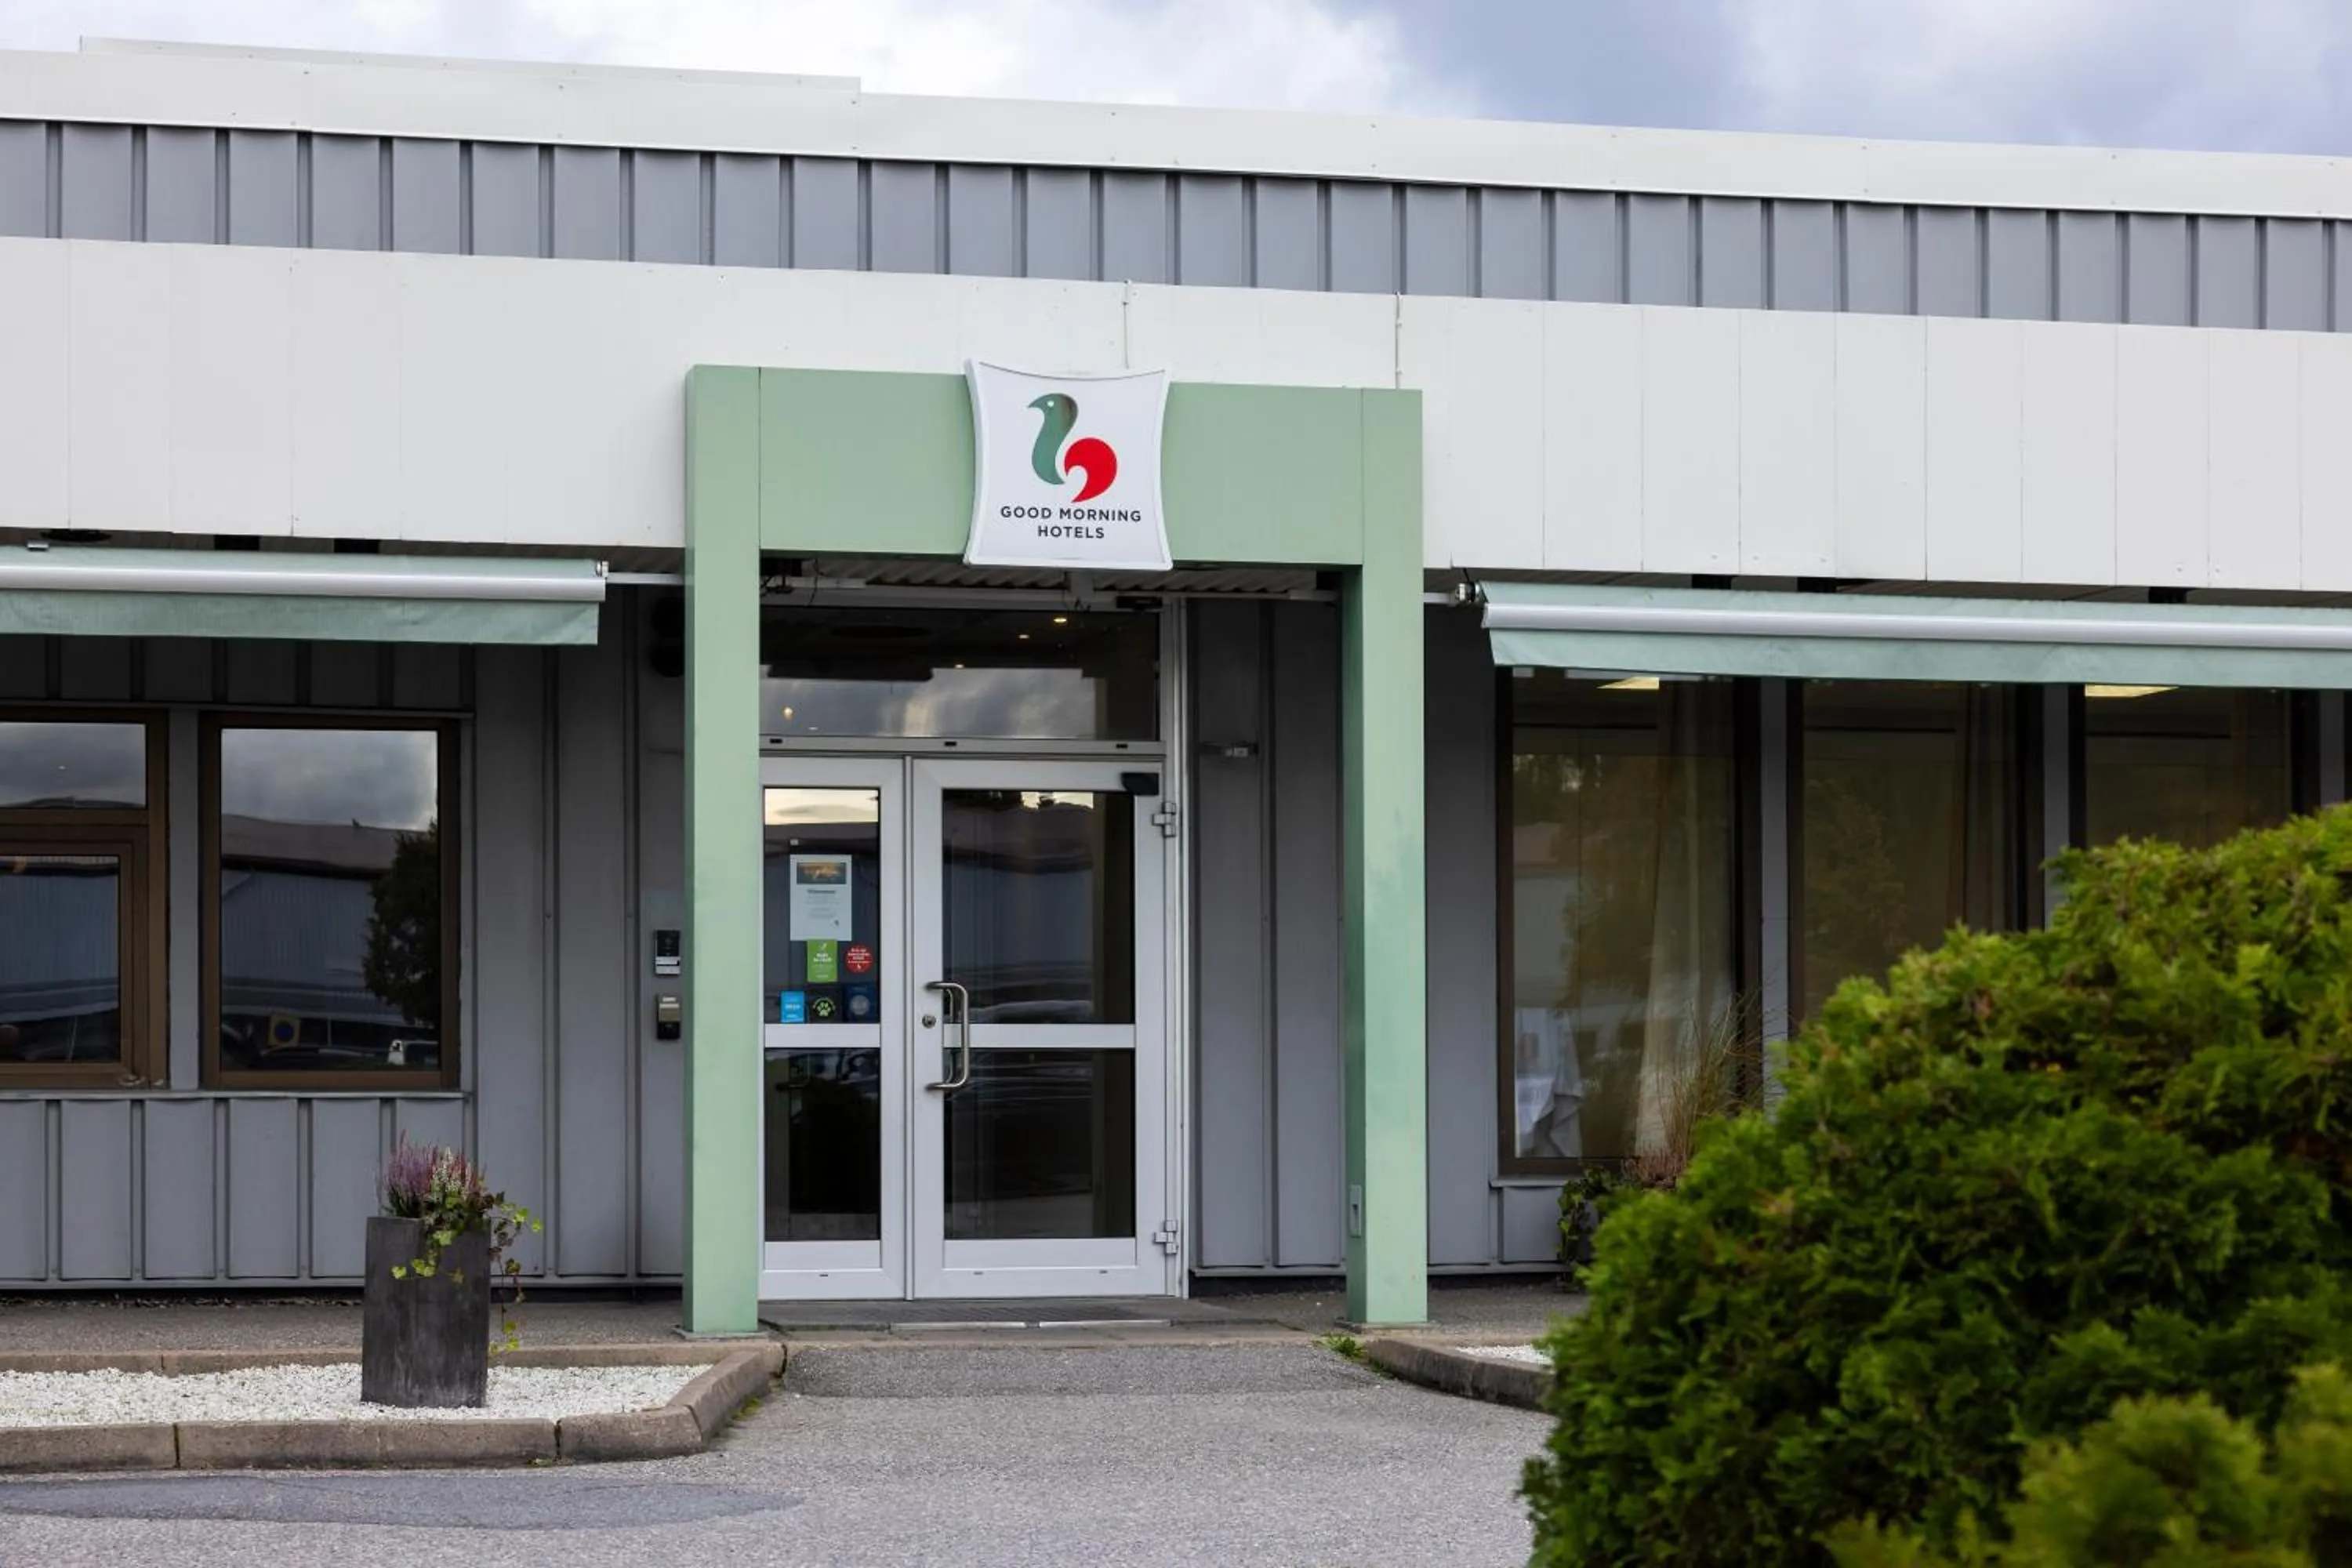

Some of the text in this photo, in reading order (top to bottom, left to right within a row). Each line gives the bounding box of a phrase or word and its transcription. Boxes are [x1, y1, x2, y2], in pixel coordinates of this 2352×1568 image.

[1000, 506, 1142, 522] GOOD MORNING
[1037, 525, 1105, 539] HOTELS
